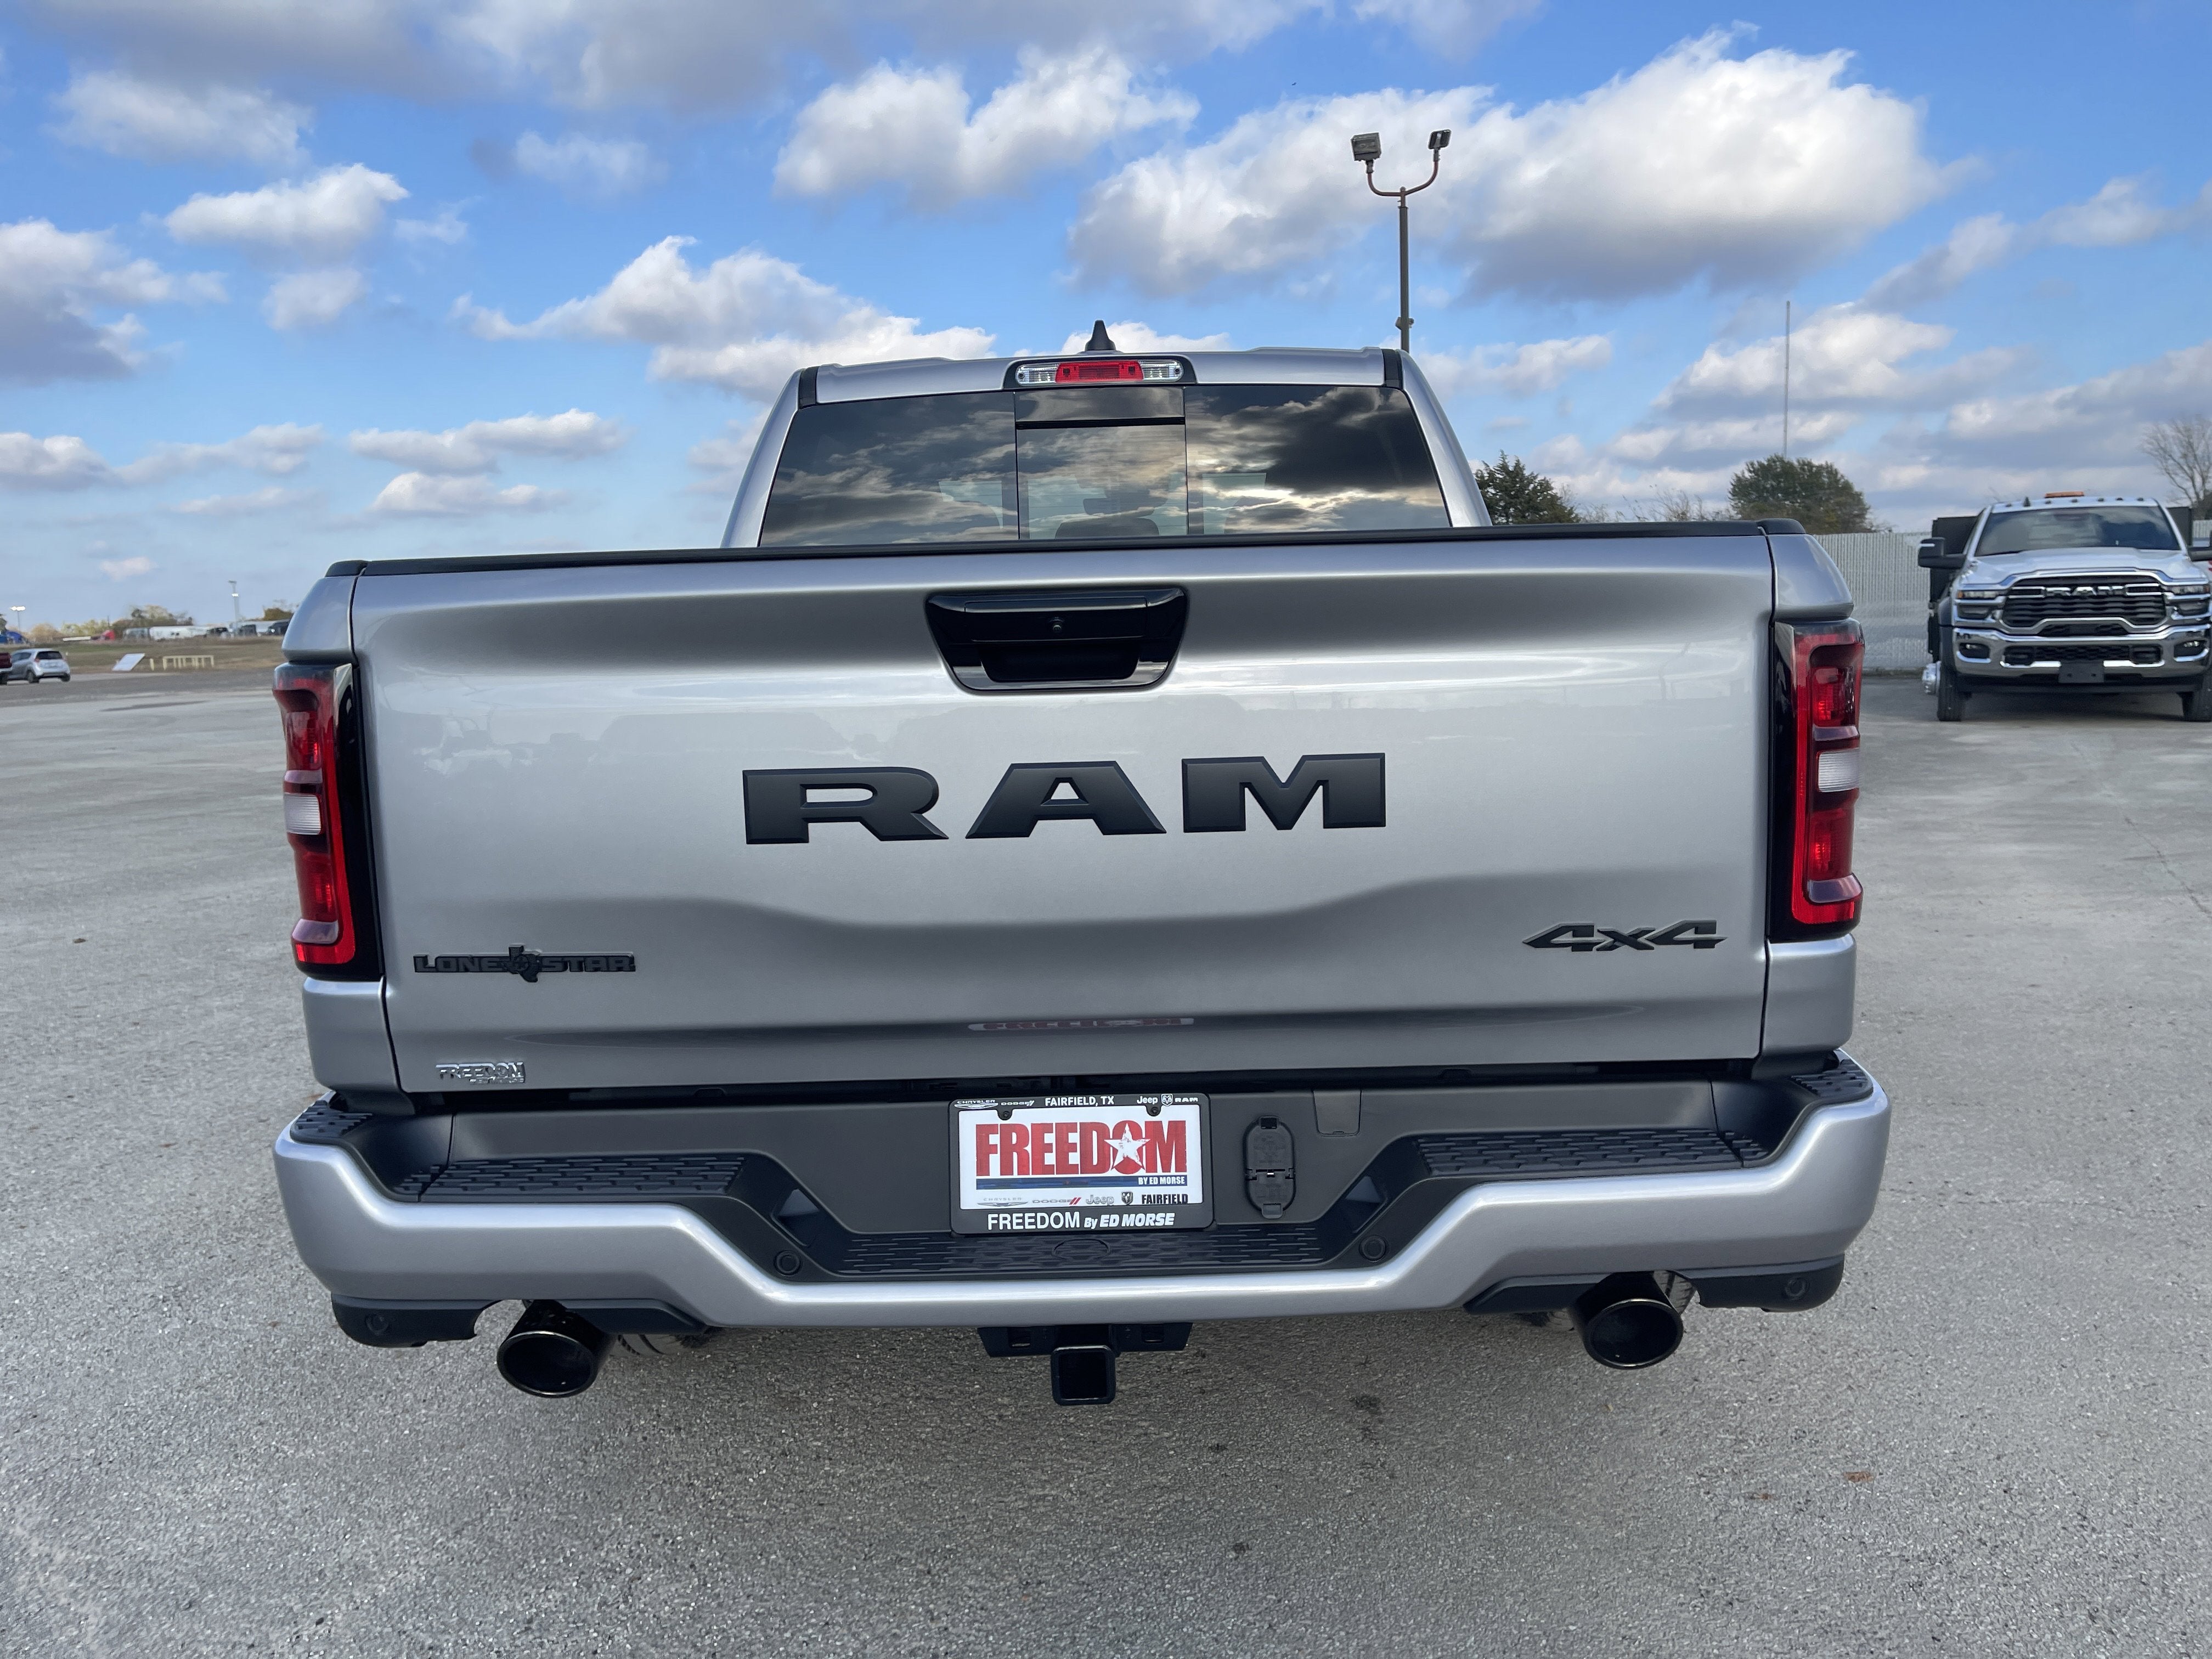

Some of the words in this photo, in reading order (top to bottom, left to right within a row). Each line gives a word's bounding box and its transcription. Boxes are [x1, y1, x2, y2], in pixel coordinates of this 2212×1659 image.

[742, 753, 1386, 845] RAM
[413, 955, 504, 973] LONE
[539, 953, 636, 972] STAR
[1045, 1097, 1098, 1107] FAIRFIELD,
[1101, 1096, 1114, 1105] TX
[1137, 1096, 1158, 1105] Jeep
[975, 1119, 1188, 1176] FREEDOM
[1159, 1176, 1185, 1184] MORSE
[1086, 1194, 1115, 1206] Jeep
[1141, 1194, 1188, 1204] FAIRFIELD
[988, 1211, 1080, 1231] FREEDOM
[1084, 1217, 1098, 1230] By
[1099, 1215, 1120, 1228] ED
[1121, 1212, 1175, 1227] MORSE
